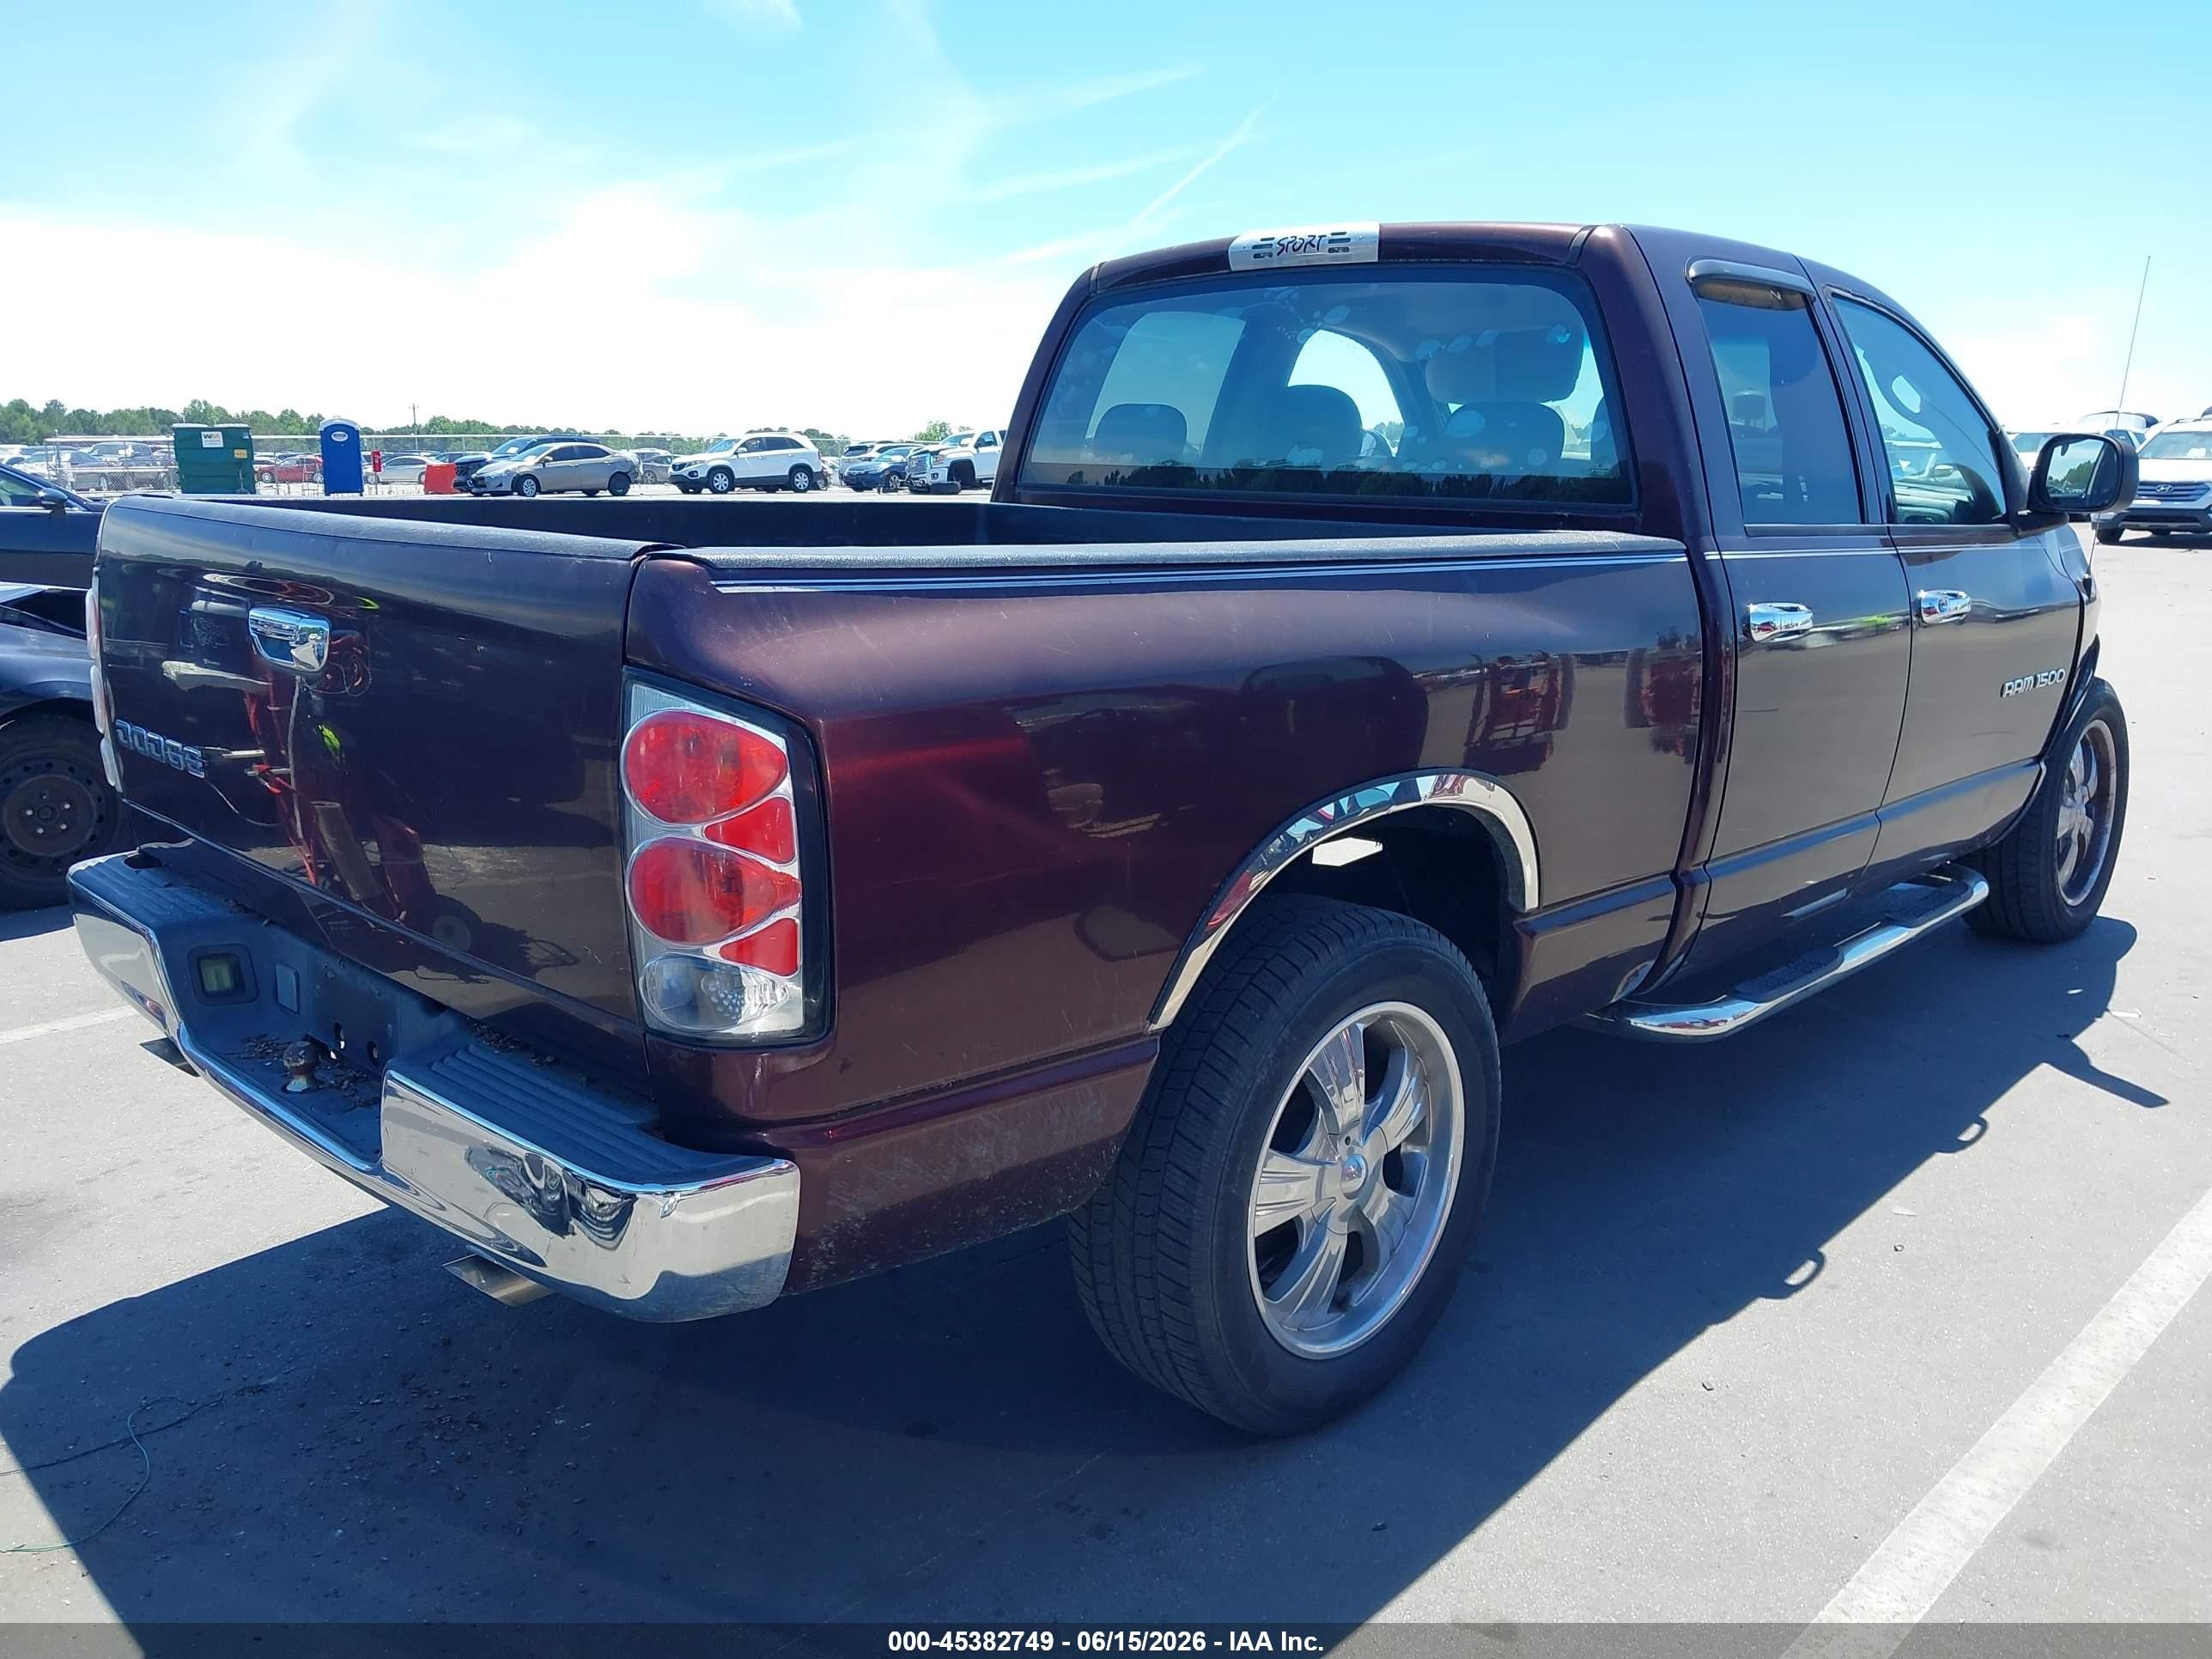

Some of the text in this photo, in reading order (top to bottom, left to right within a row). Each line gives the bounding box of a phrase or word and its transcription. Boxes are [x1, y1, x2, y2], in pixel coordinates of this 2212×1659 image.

[1277, 235, 1328, 256] SPORT
[2002, 668, 2066, 698] RAM 1500
[114, 719, 206, 779] DODGE
